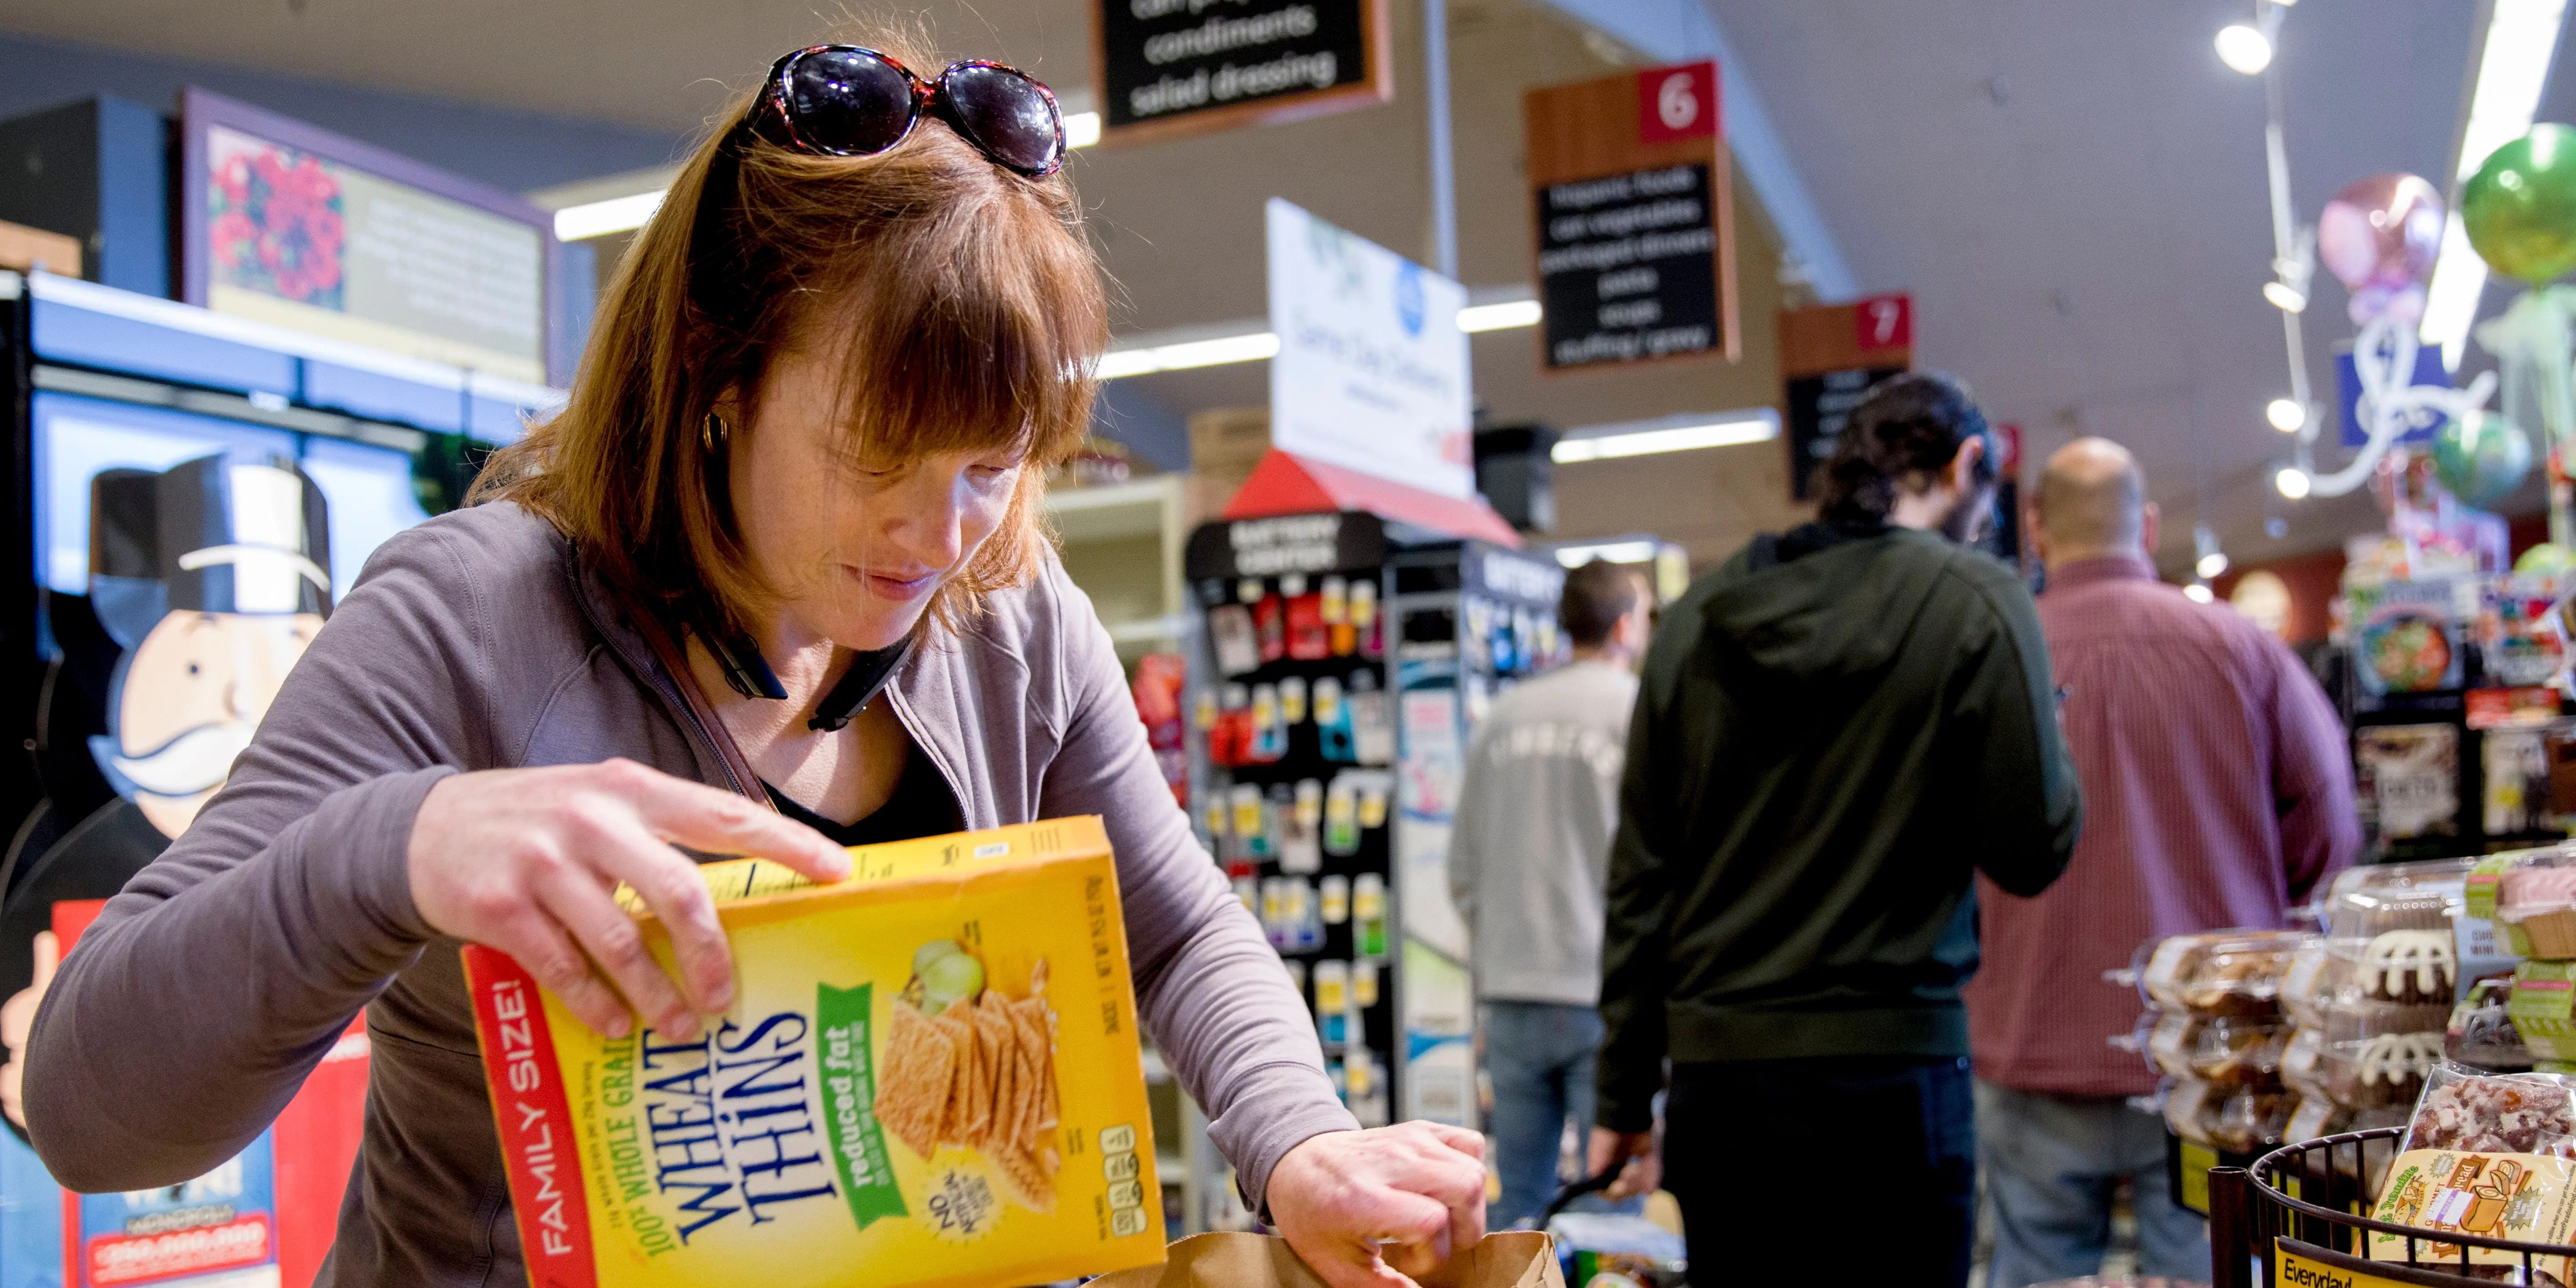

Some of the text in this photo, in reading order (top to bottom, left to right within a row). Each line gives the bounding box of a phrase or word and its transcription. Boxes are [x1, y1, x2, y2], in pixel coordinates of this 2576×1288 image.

[1144, 5, 1319, 65] condiments
[1130, 51, 1337, 117] salad dressing
[1657, 72, 1699, 129] 6
[1868, 301, 1901, 344] 7
[493, 978, 572, 1256] FAMILY SIZE!
[643, 1027, 742, 1247] WHEAT
[825, 1026, 865, 1187] reduced fat
[605, 1115, 652, 1216] WHOLE
[631, 1198, 678, 1257] 100%
[2441, 1195, 2455, 1215] BAKERY
